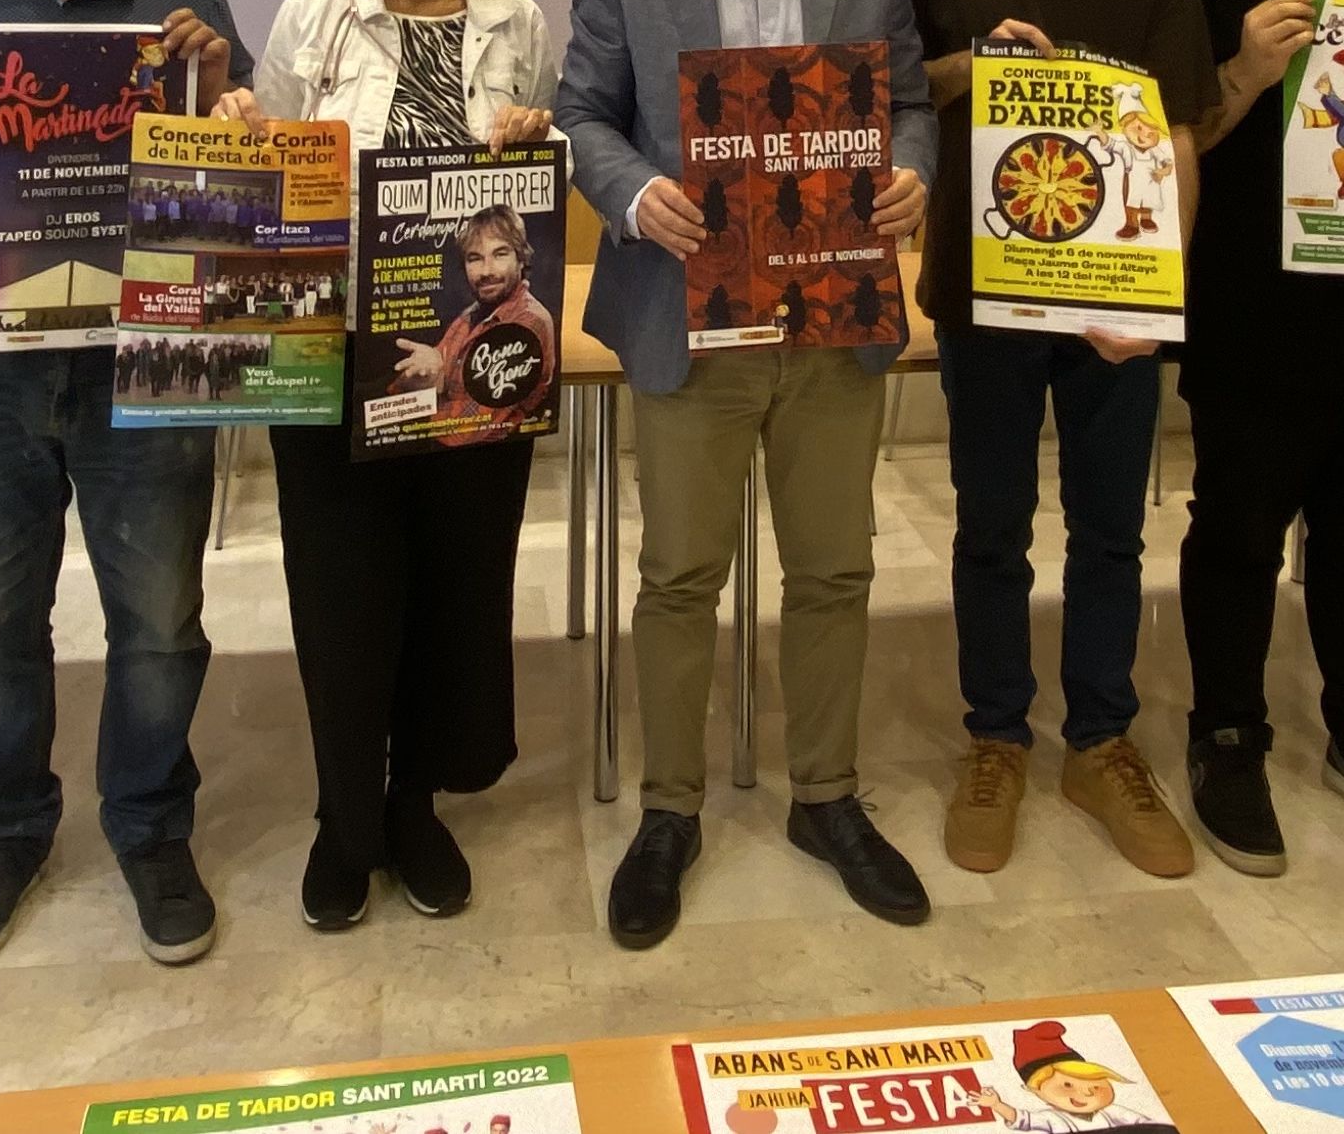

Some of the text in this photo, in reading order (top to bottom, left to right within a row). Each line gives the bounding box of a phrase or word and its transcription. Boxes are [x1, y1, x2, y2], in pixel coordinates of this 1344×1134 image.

[1002, 67, 1092, 81] CONCURS DE
[989, 80, 1114, 107] PAELLES
[148, 126, 336, 148] Concert de Corals
[690, 128, 881, 161] FESTA DE TARDOR
[47, 154, 100, 164] DIVENDRES
[148, 144, 336, 165] de la Festa de Tardor
[376, 157, 408, 169] FESTA
[410, 157, 424, 166] DE
[427, 154, 466, 165] TARDOR
[765, 152, 881, 172] SANT MARTÍ 2022
[18, 164, 129, 180] 11 DE NOVEMBRE
[21, 190, 29, 198] A
[31, 187, 68, 198] PARTIR
[69, 186, 84, 196] DE
[86, 185, 104, 195] LES
[382, 184, 423, 215] QUIM
[436, 172, 551, 211] MASFERRER
[46, 212, 101, 225] DJ EROS
[44, 228, 89, 240] SOUND
[379, 214, 470, 249] a Cerdanyola
[768, 255, 785, 266] DEL
[788, 255, 793, 264] 5
[796, 254, 808, 264] AL
[821, 251, 834, 262] DE
[836, 248, 884, 261] NOVEMBRE
[1004, 244, 1156, 262] Diumenge 6 de novembre
[373, 254, 443, 269] DIUMENGE
[1003, 255, 1036, 268] Plaça
[1038, 258, 1079, 269] Jaume
[1082, 260, 1111, 271] Grau
[373, 267, 442, 283] 6 DE NOVEMBRE
[1025, 268, 1034, 277] A
[1036, 269, 1054, 278] les
[1056, 270, 1070, 279] 12
[1073, 271, 1092, 281] del
[168, 285, 202, 295] Coral
[138, 293, 202, 305] La Ginesta
[372, 296, 430, 310] a l'envelat
[144, 302, 162, 313] del
[371, 308, 435, 321] de la Plaça
[371, 320, 440, 333] Sant Ramon
[471, 340, 528, 379] Bona
[488, 356, 541, 399] Gent
[369, 395, 417, 412] Entrades
[370, 403, 432, 423] anticipades
[1271, 996, 1314, 1011] FESTA
[1315, 994, 1332, 1007] DE
[712, 1037, 986, 1075] ABANS DE SANT MARTÍ
[1259, 1043, 1334, 1058] Diumenge
[1273, 1059, 1294, 1072] de
[1271, 1078, 1283, 1091] a
[1286, 1075, 1309, 1089] les
[1308, 1073, 1327, 1087] 10
[112, 1064, 550, 1127] FESTA DE TARDOR SANT MARTÍ 2022
[817, 1075, 982, 1129] FESTA
